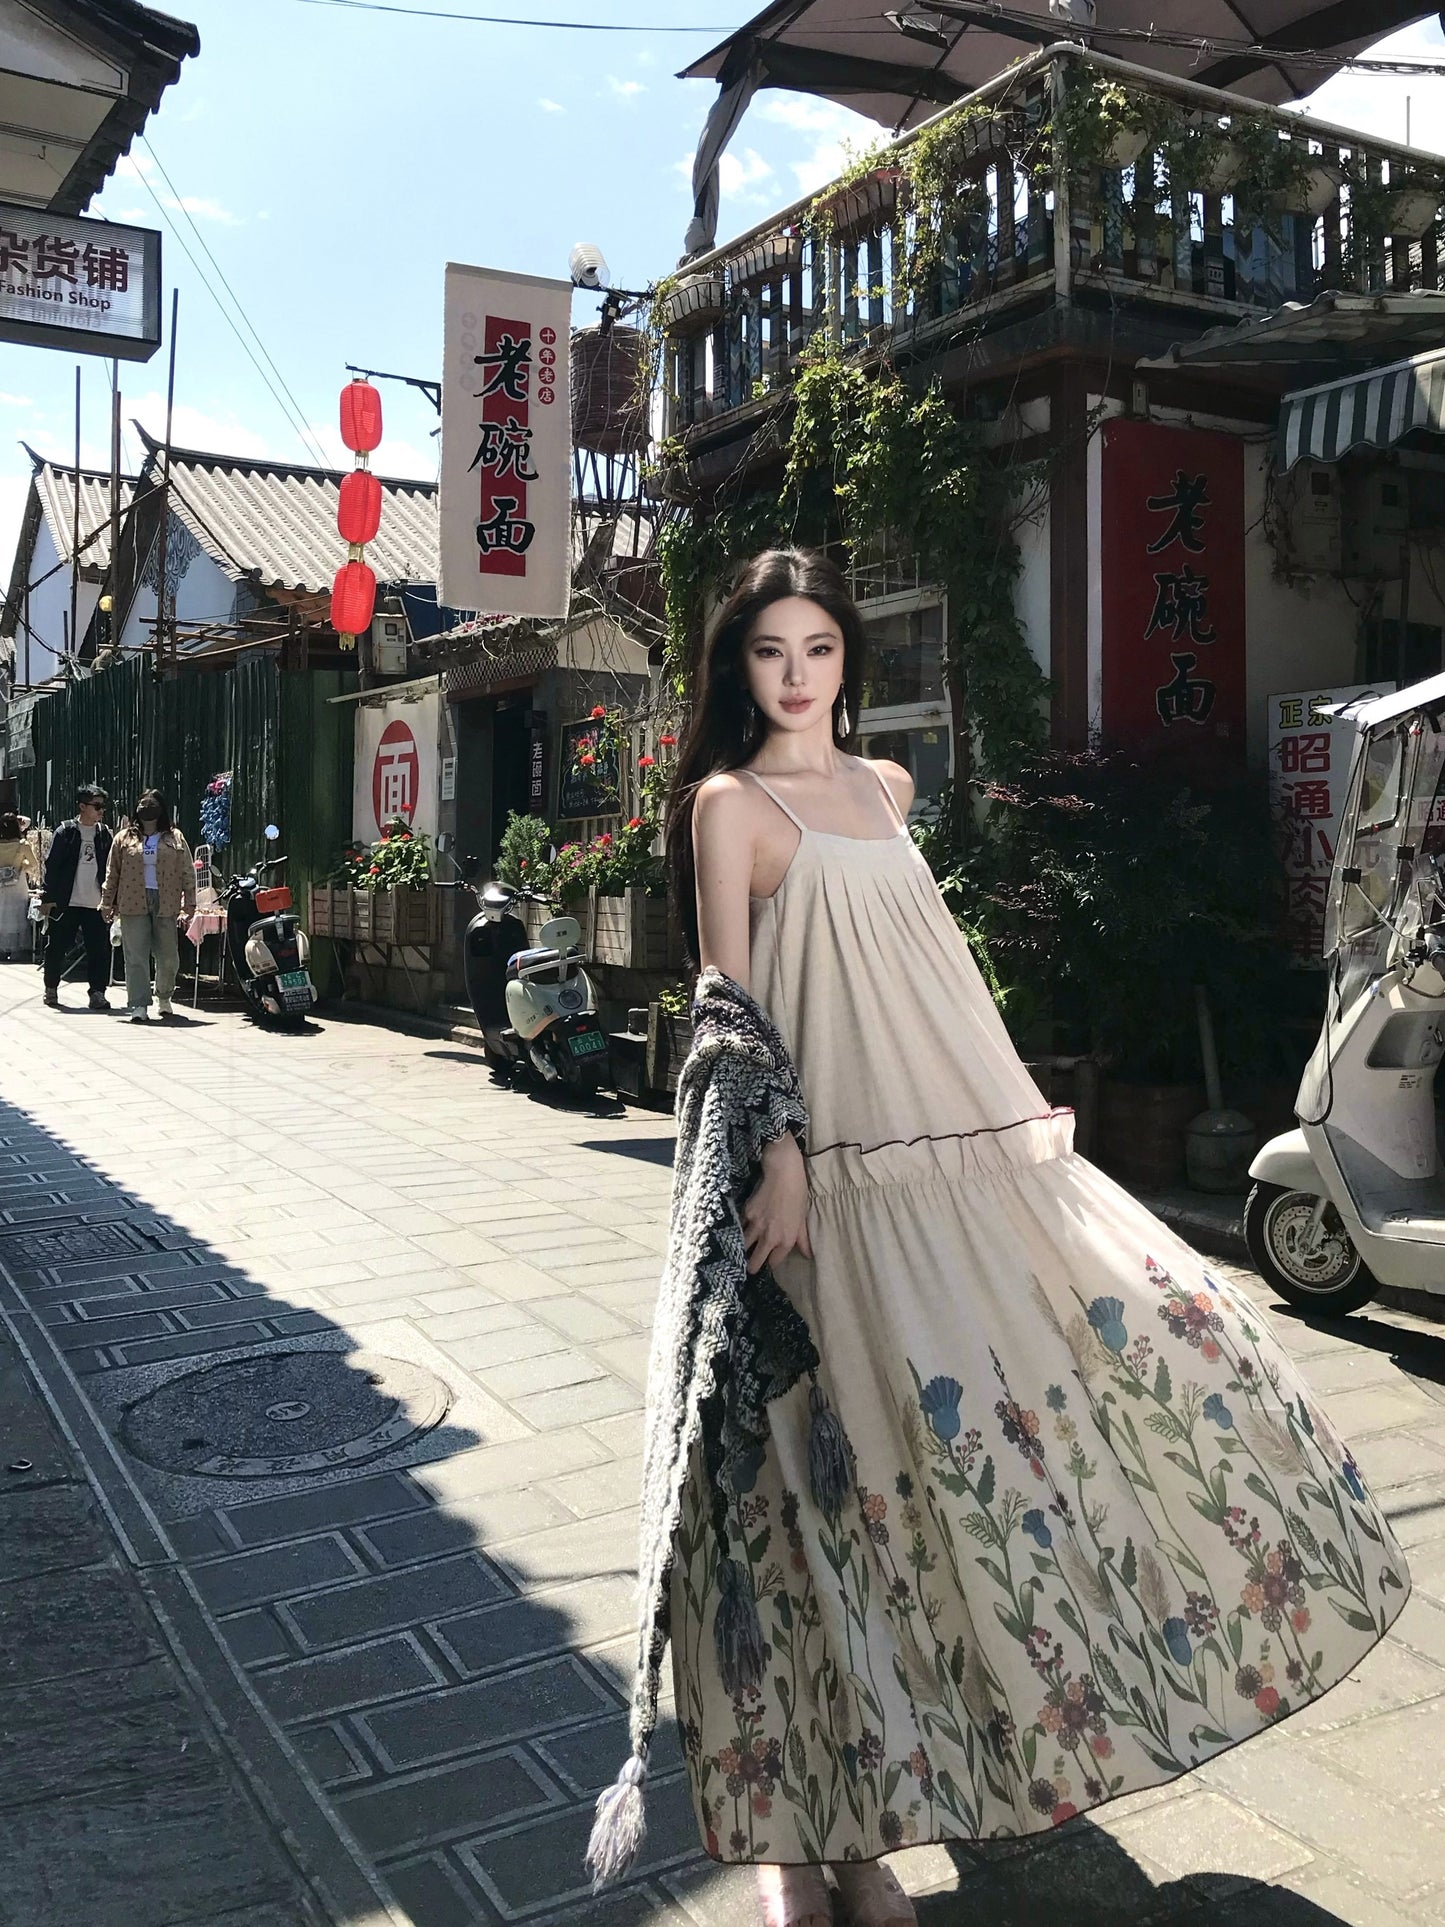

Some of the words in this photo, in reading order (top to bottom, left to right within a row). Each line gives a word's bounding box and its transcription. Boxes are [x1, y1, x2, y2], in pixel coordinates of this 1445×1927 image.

[0, 226, 129, 293] 杂货铺
[0, 279, 63, 303] Fashion
[68, 291, 111, 312] Shop
[539, 328, 555, 403] 十年老店
[467, 333, 539, 554] 老碗面
[1144, 469, 1217, 727] 老碗面
[1279, 695, 1333, 729] 正宗
